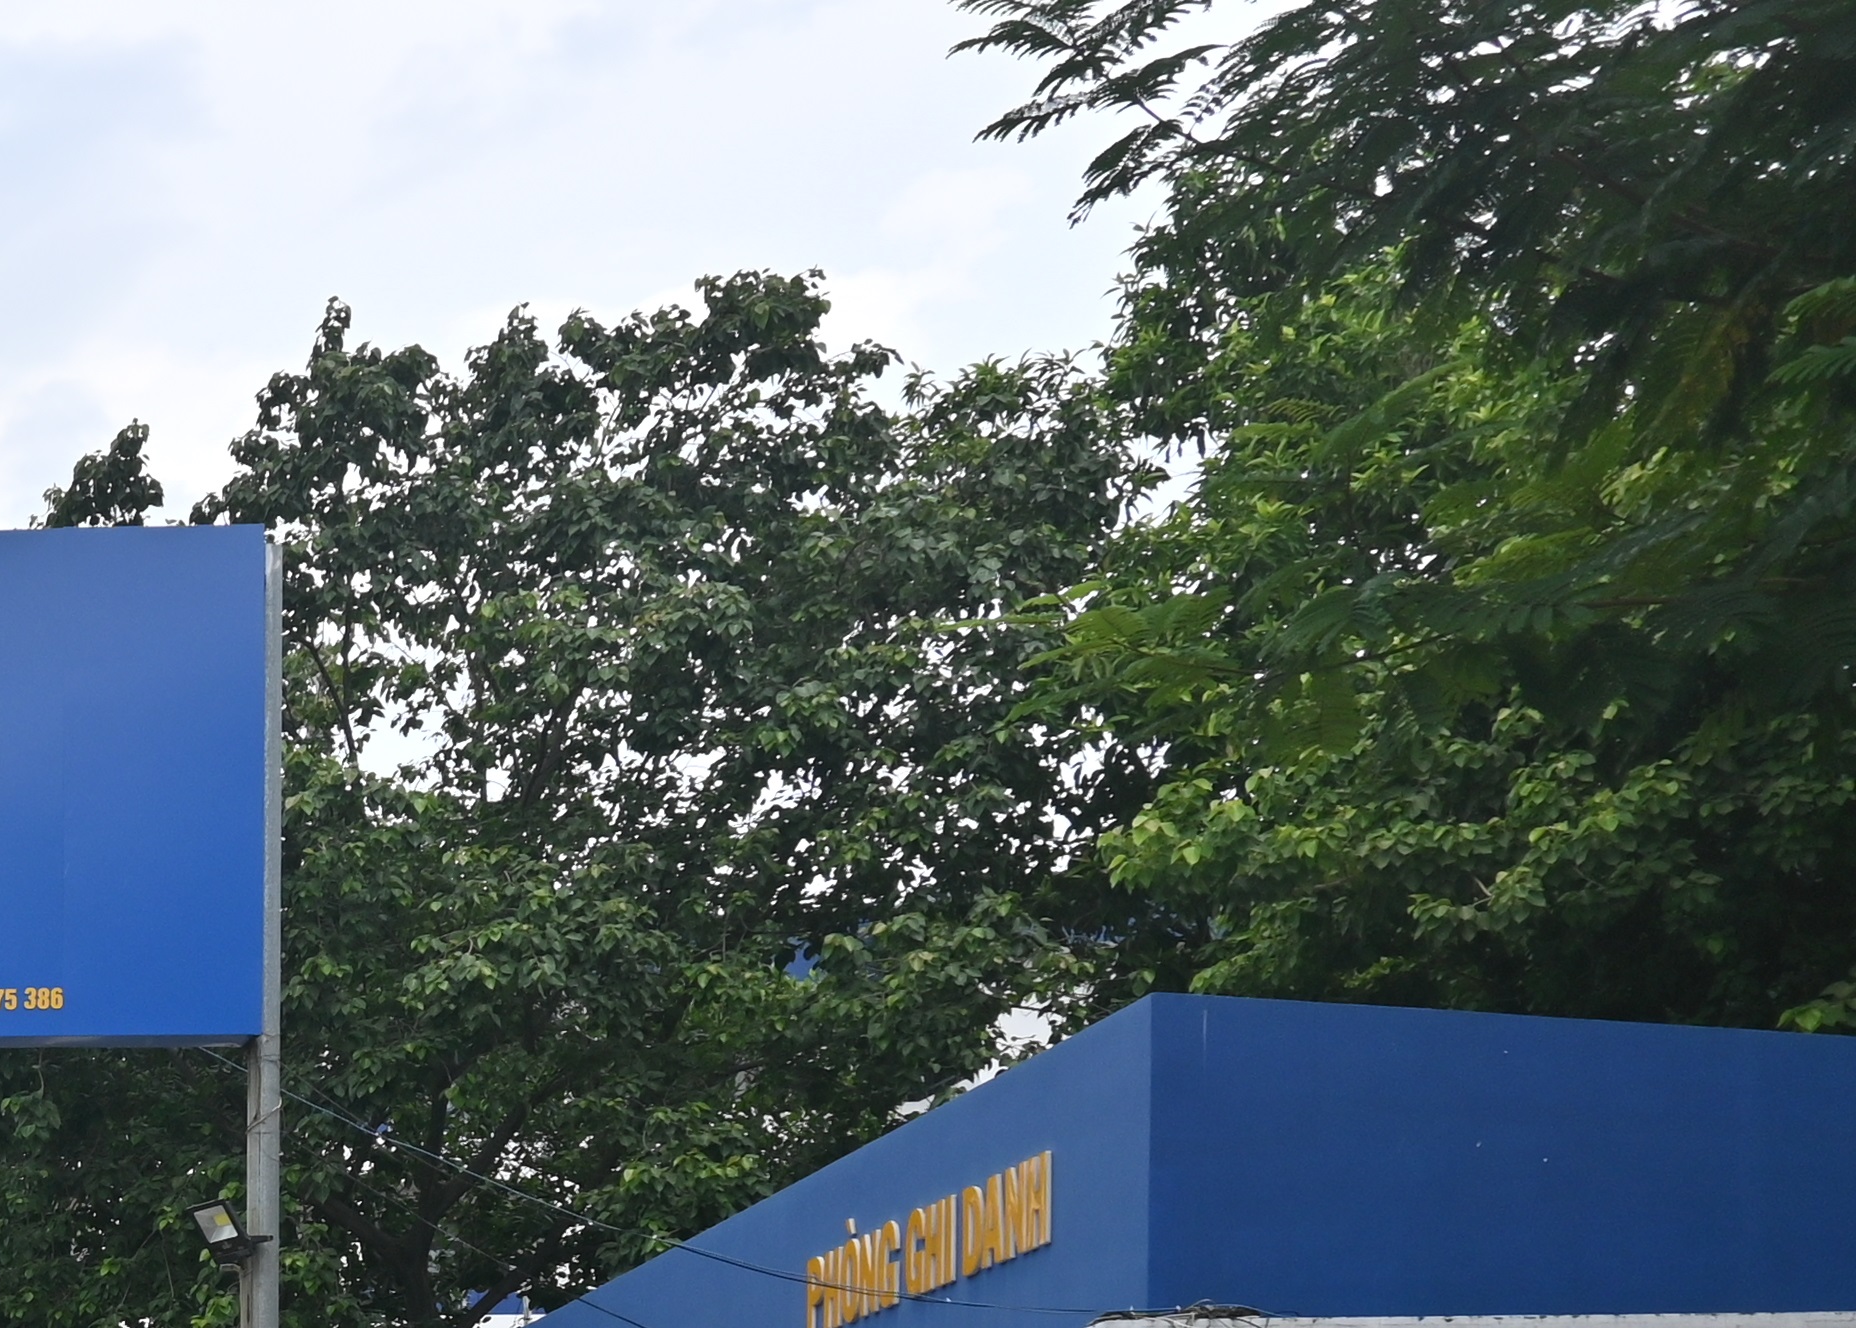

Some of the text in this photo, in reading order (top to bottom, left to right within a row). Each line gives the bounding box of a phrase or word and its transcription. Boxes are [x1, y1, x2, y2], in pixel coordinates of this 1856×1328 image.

[24, 988, 64, 1010] 386
[906, 1195, 957, 1294] GHI
[962, 1150, 1052, 1277] DANH
